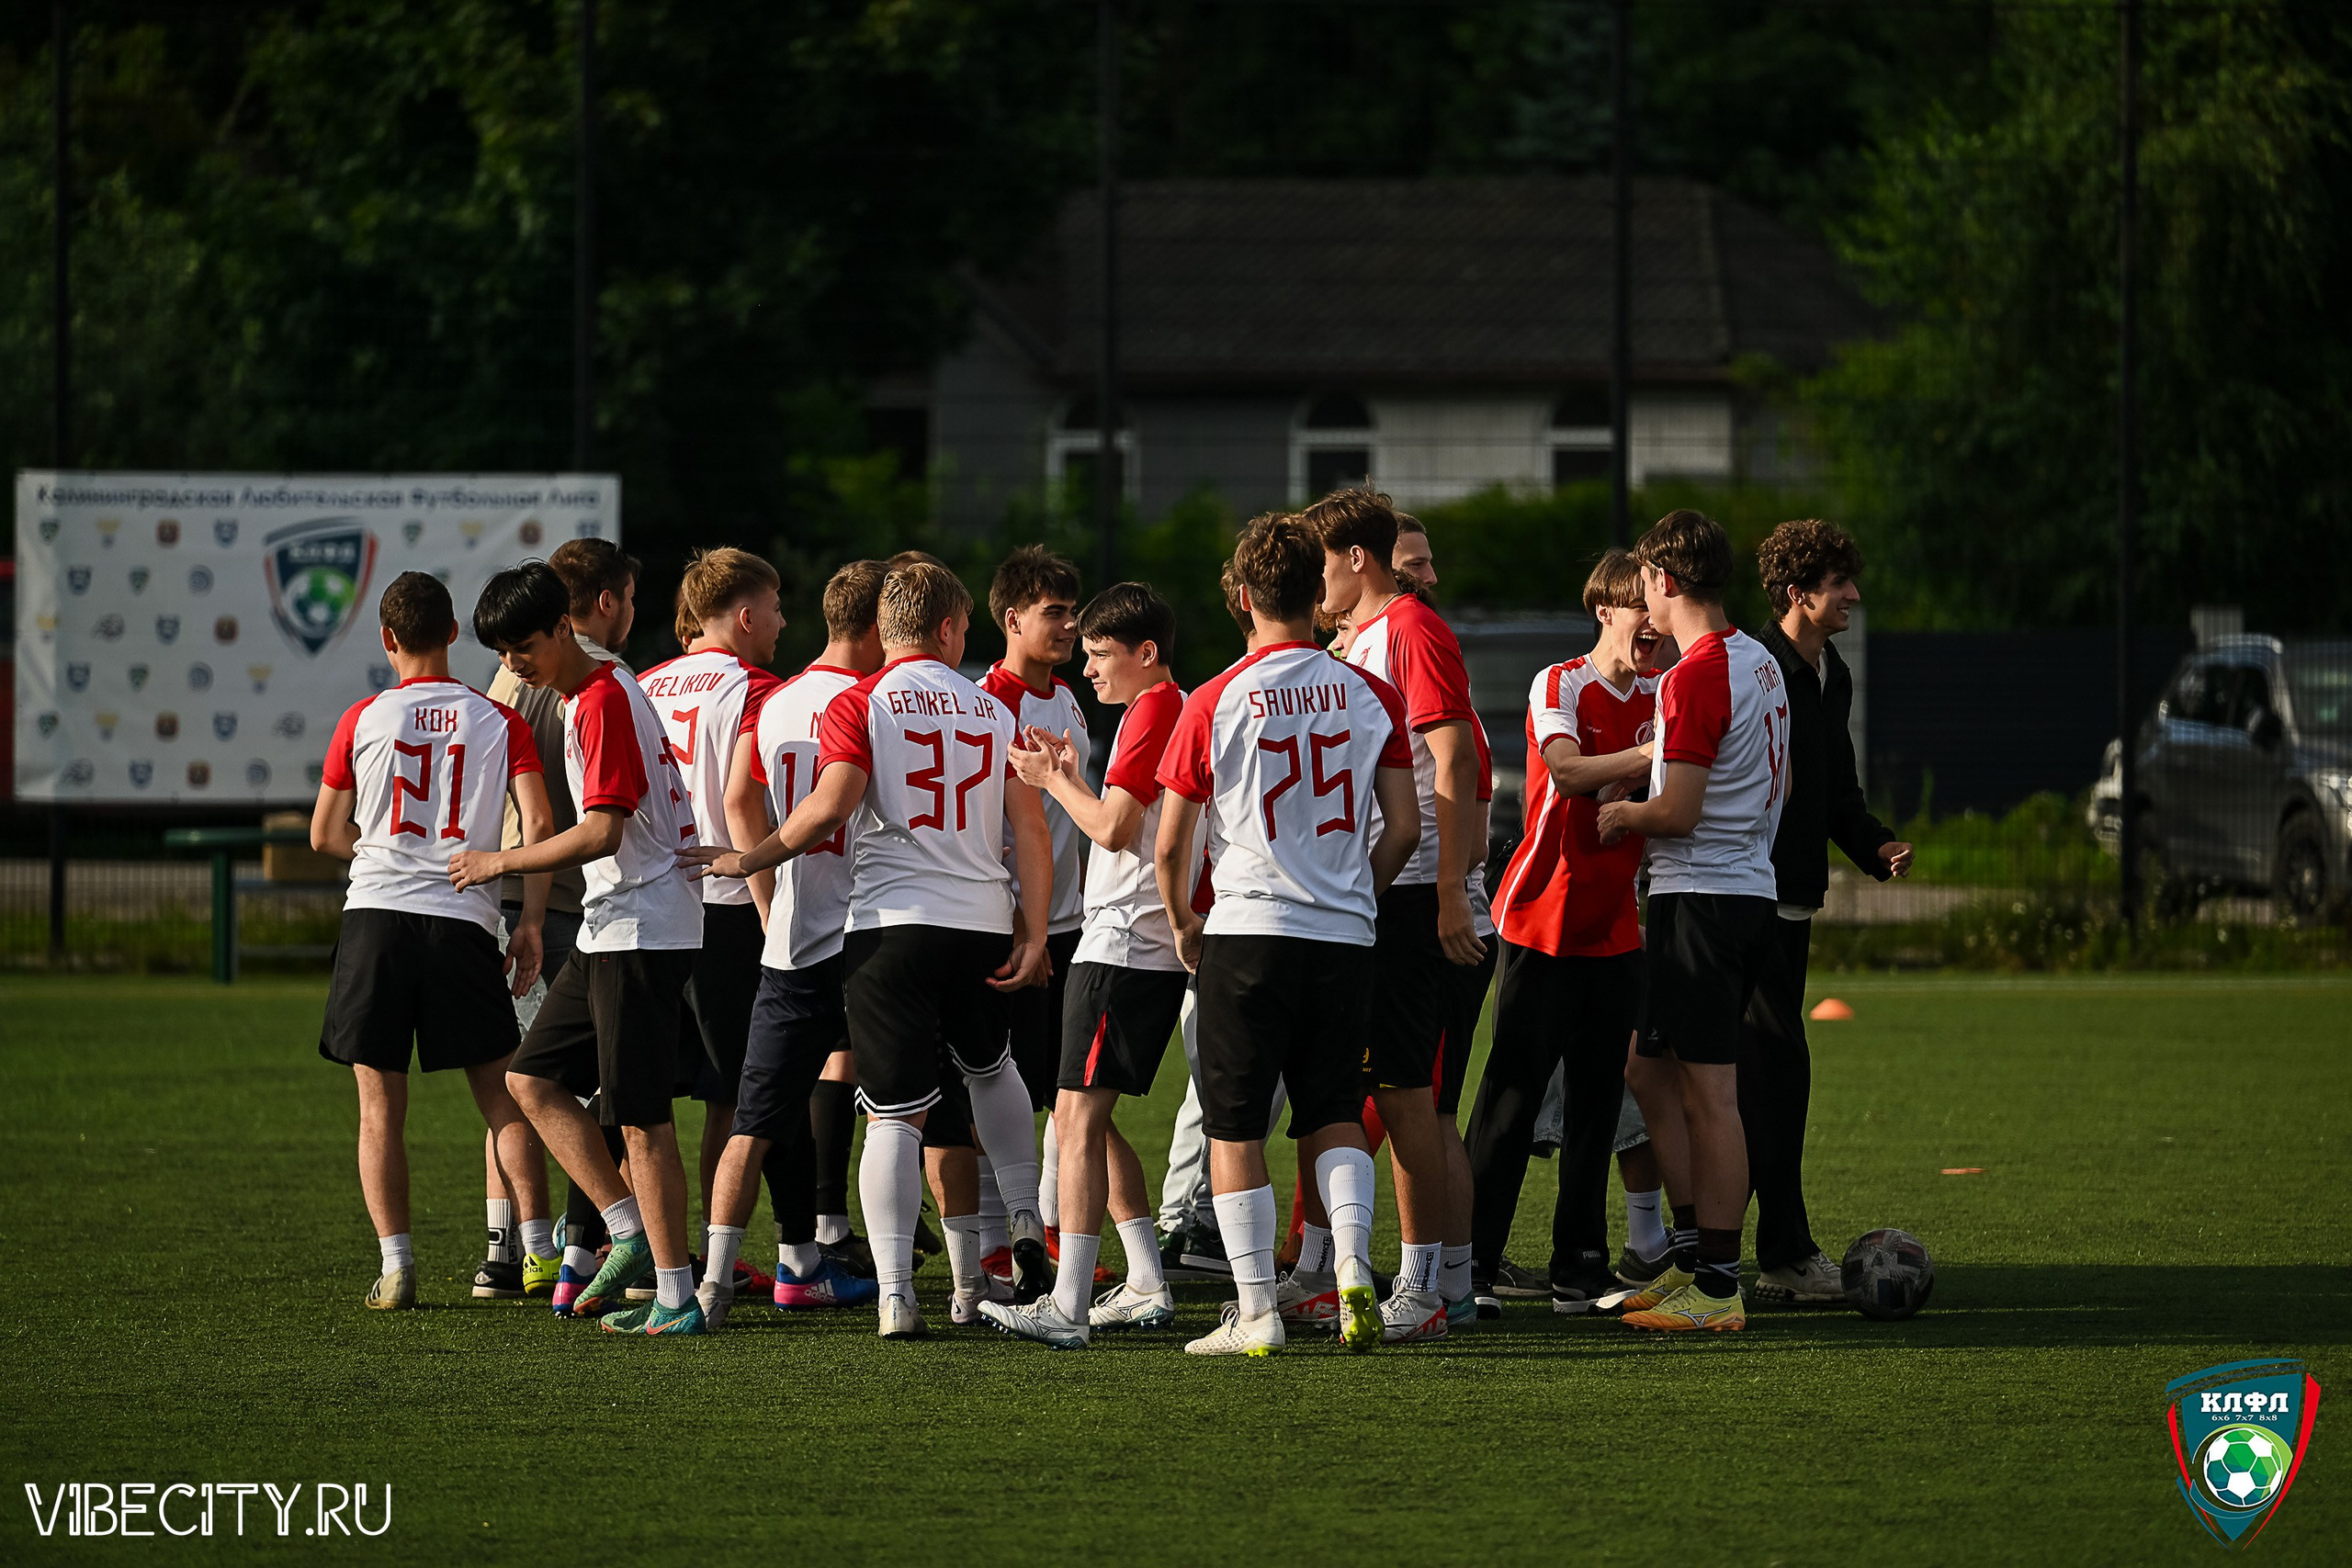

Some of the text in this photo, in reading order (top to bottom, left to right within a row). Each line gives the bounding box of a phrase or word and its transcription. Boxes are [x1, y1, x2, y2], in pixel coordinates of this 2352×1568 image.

[647, 672, 725, 697] BELIKOV
[888, 690, 998, 720] GENKEL JR
[390, 739, 466, 840] 21
[904, 728, 993, 831] 37
[1258, 728, 1355, 842] 75
[804, 1289, 838, 1304] adidas
